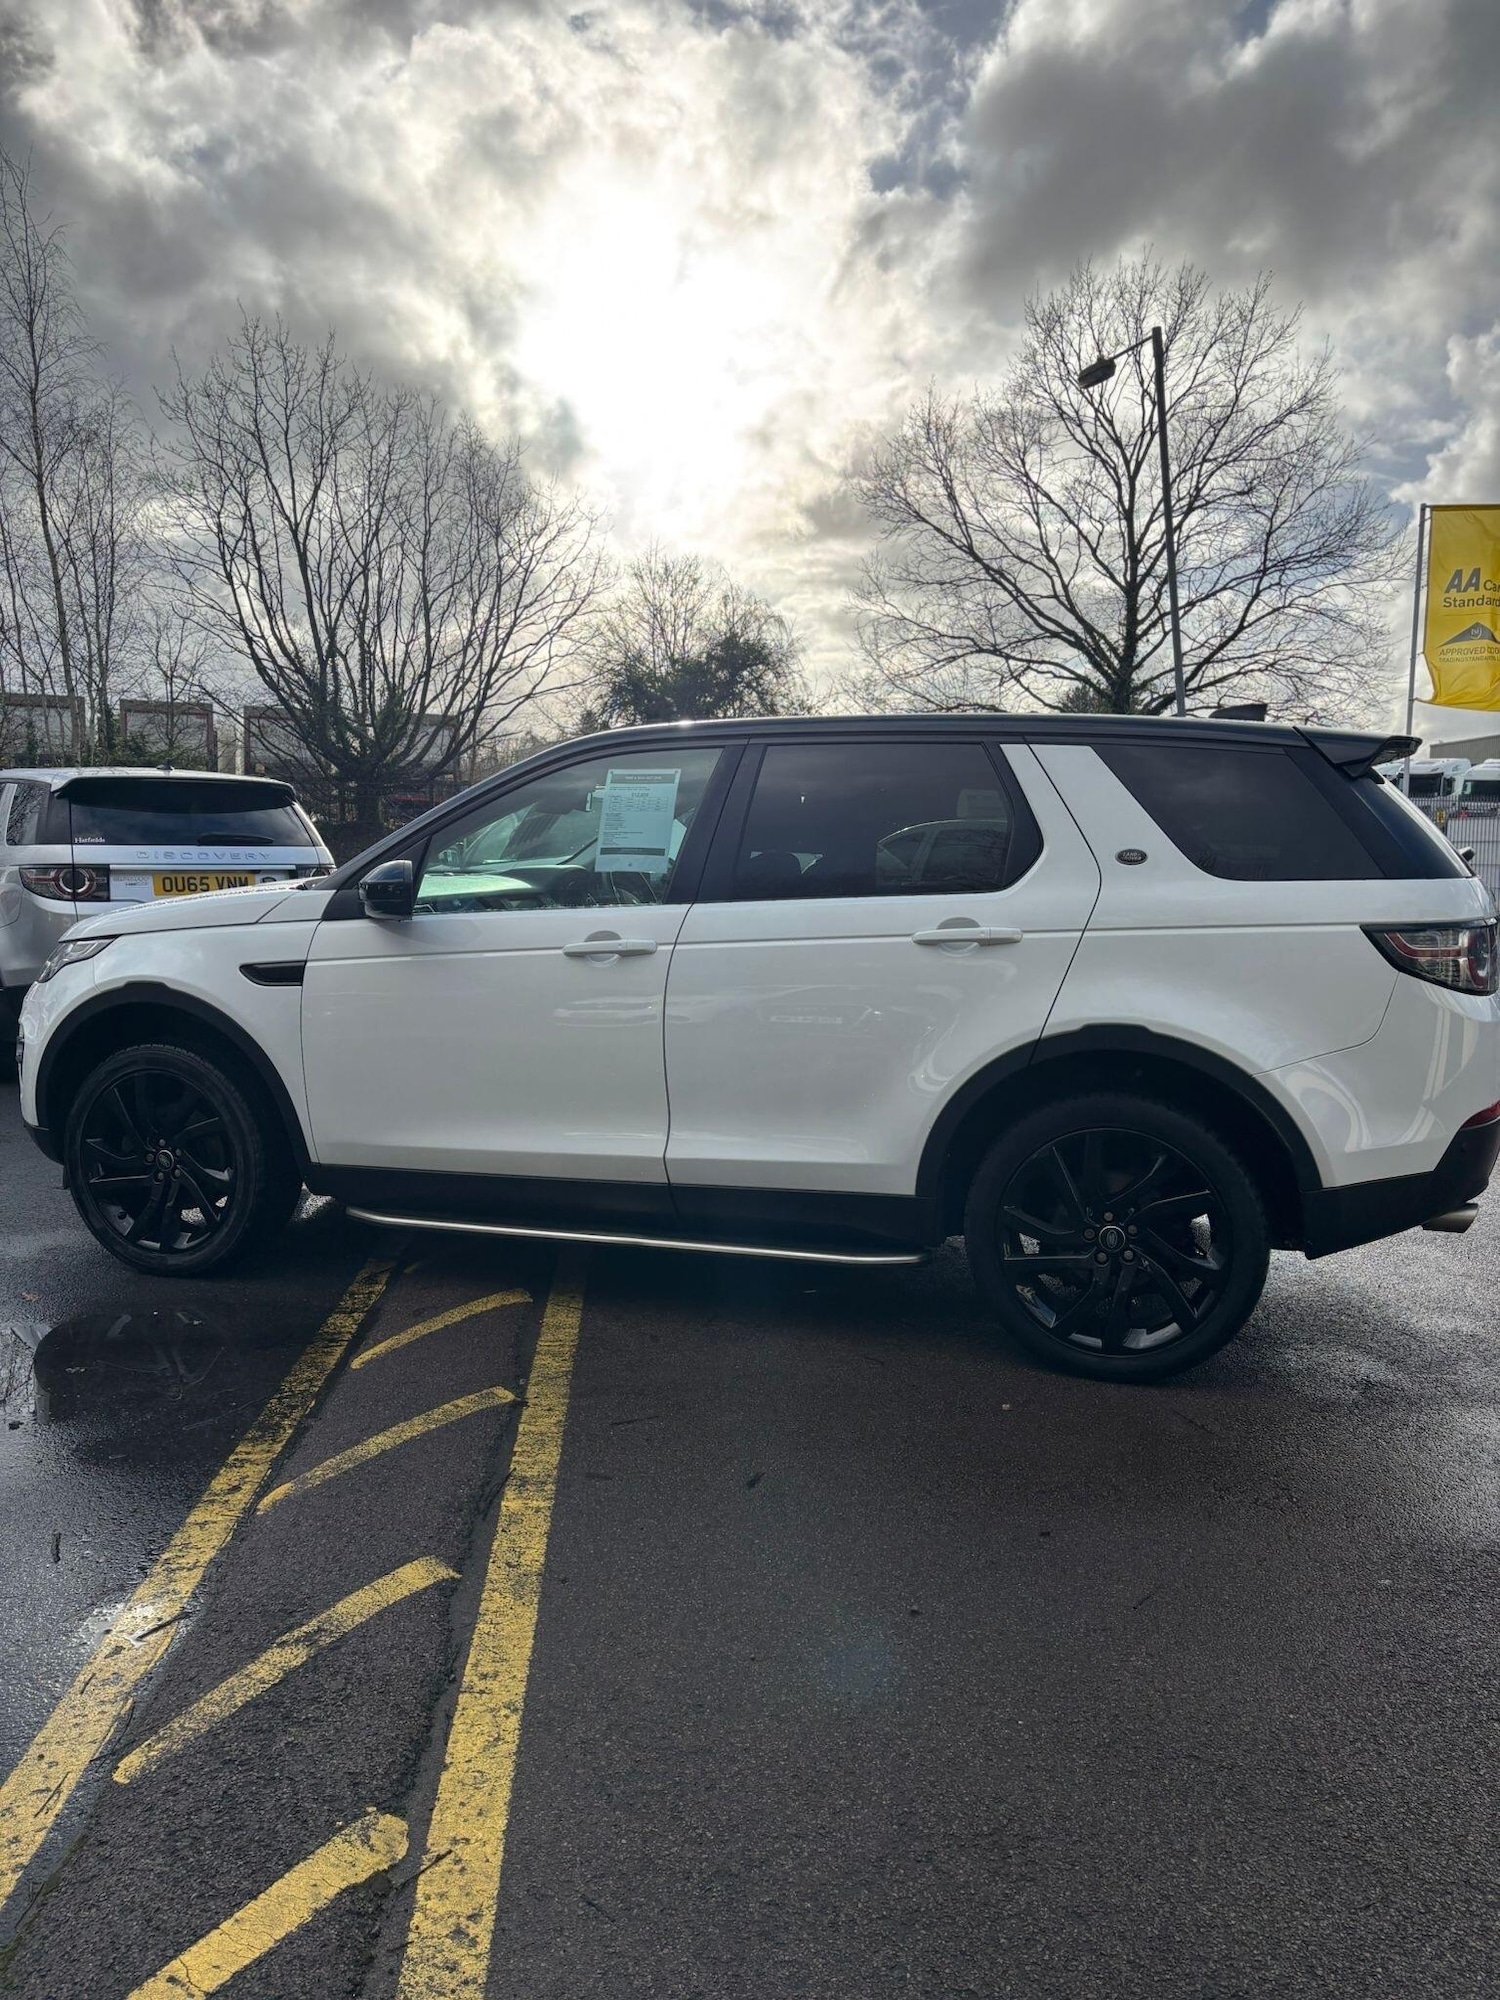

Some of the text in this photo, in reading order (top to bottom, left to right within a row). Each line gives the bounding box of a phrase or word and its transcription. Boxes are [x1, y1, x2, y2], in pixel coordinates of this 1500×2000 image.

[1444, 567, 1481, 594] AA
[1439, 646, 1486, 656] APPROVED
[136, 851, 272, 860] DISCOVERY
[162, 876, 251, 893] OU65 VNM
